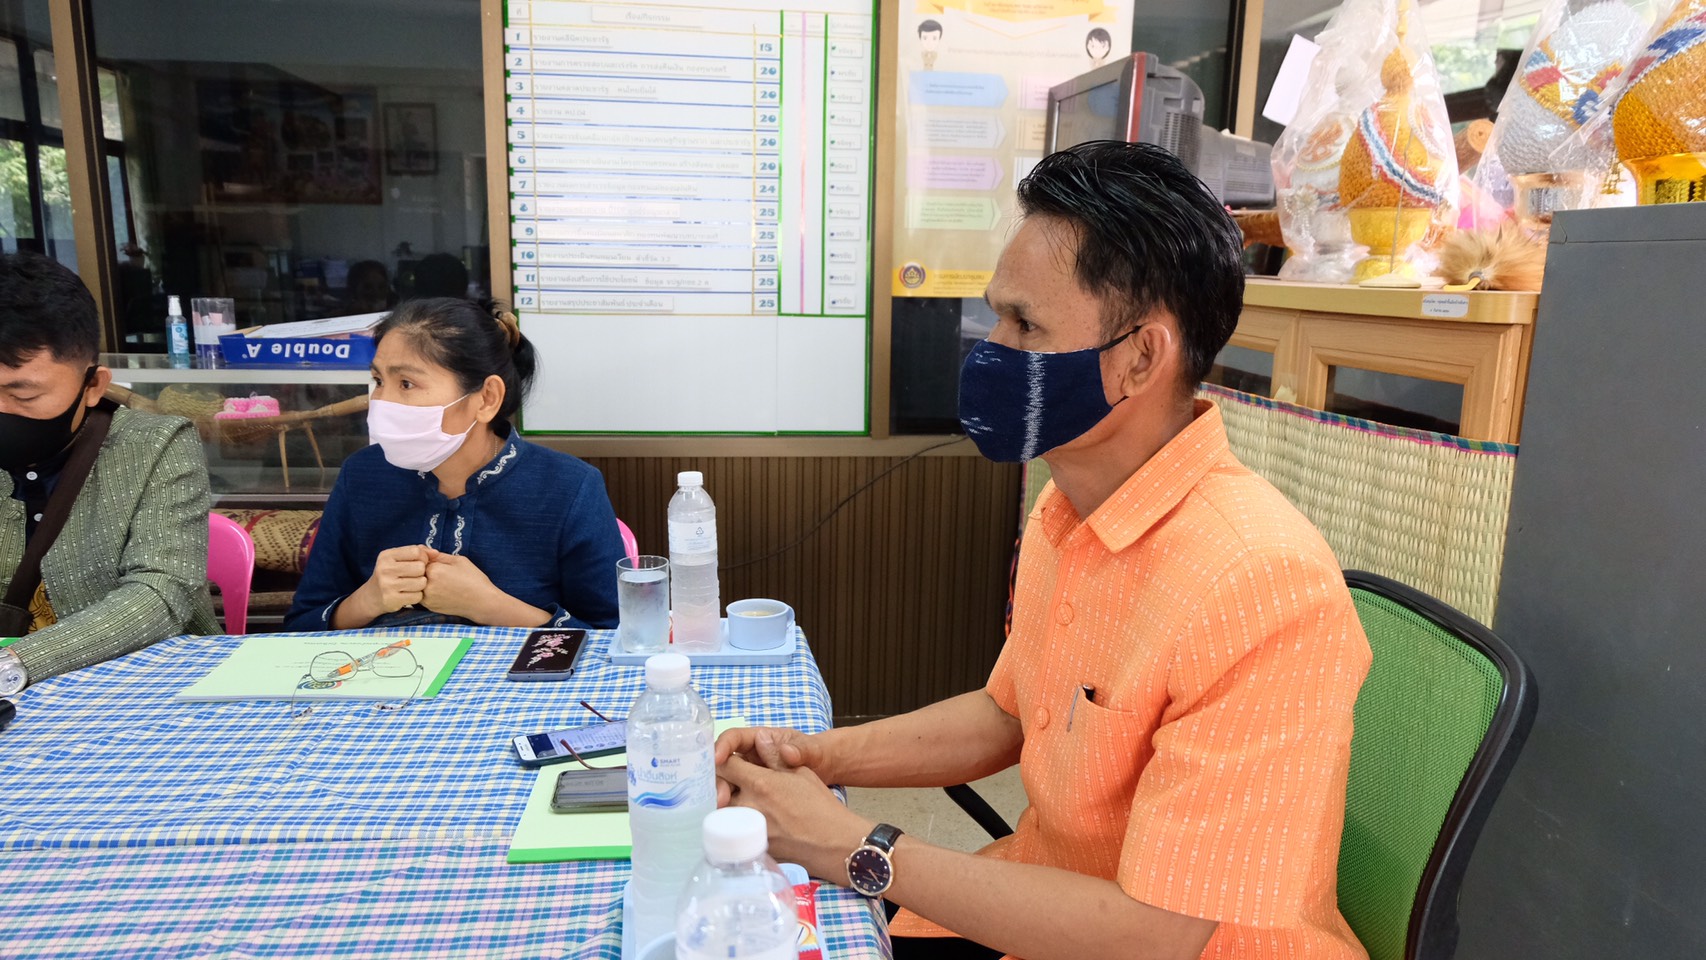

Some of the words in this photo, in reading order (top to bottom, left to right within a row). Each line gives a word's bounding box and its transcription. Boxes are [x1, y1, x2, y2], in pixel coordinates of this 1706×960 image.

[516, 32, 521, 41] 1
[760, 43, 773, 52] 15
[515, 57, 523, 66] 2
[760, 67, 776, 75] 20
[515, 82, 524, 91] 3
[760, 91, 776, 99] 20
[516, 106, 525, 115] 4
[760, 115, 776, 123] 20
[517, 131, 525, 139] 5
[760, 138, 776, 147] 20
[517, 155, 526, 164] 6
[760, 162, 776, 171] 20
[519, 180, 527, 189] 7
[760, 185, 776, 193] 24
[760, 208, 775, 217] 25
[525, 227, 534, 236] 9
[760, 231, 775, 240] 25
[521, 250, 534, 259] 10
[759, 254, 775, 263] 25
[525, 273, 536, 282] 11
[759, 278, 774, 286] 25
[521, 296, 533, 305] 12
[759, 299, 775, 308] 25
[246, 343, 262, 358] A
[272, 343, 351, 359] Double
